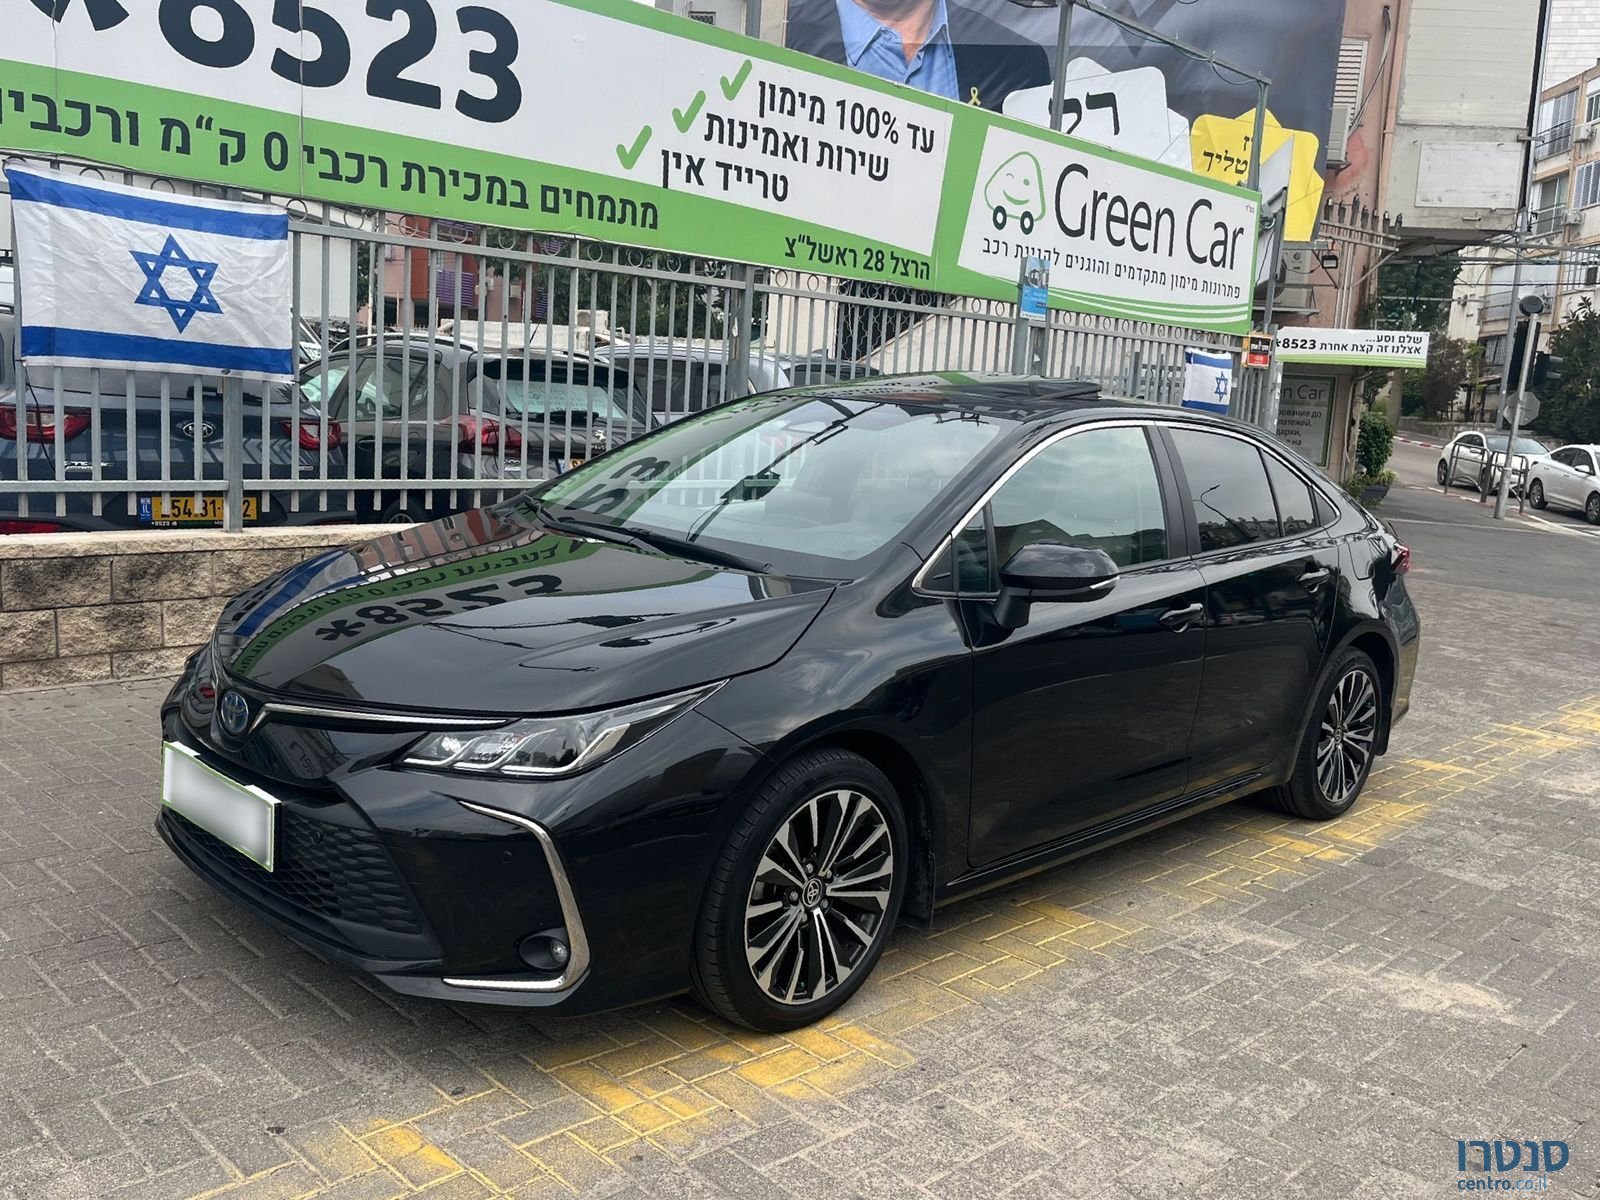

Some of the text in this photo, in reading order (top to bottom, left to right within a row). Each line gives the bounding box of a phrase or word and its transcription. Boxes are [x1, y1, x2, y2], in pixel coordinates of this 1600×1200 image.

[0, 88, 139, 146] ורכבי
[758, 80, 935, 153] עד 100% מימון
[264, 131, 289, 172] 0
[704, 112, 889, 182] שירות ואמינות
[303, 144, 388, 188] רכבי
[661, 149, 788, 202] טרייד אין
[1203, 150, 1248, 175] טליך
[400, 161, 529, 210] במכירת
[540, 184, 658, 230] מתמחים
[1055, 163, 1244, 270] Green Car
[863, 247, 885, 272] 28
[982, 238, 1009, 258] רכב
[890, 251, 930, 280] הרצל
[1066, 254, 1109, 275] והוגנים
[1115, 264, 1166, 286] מתקדמים
[1170, 273, 1198, 291] מימון
[1202, 279, 1241, 299] פתרונות
[1320, 342, 1421, 354] אצלנו זה קצת אחרת
[1399, 334, 1423, 344] שלם
[1297, 384, 1326, 400] Car
